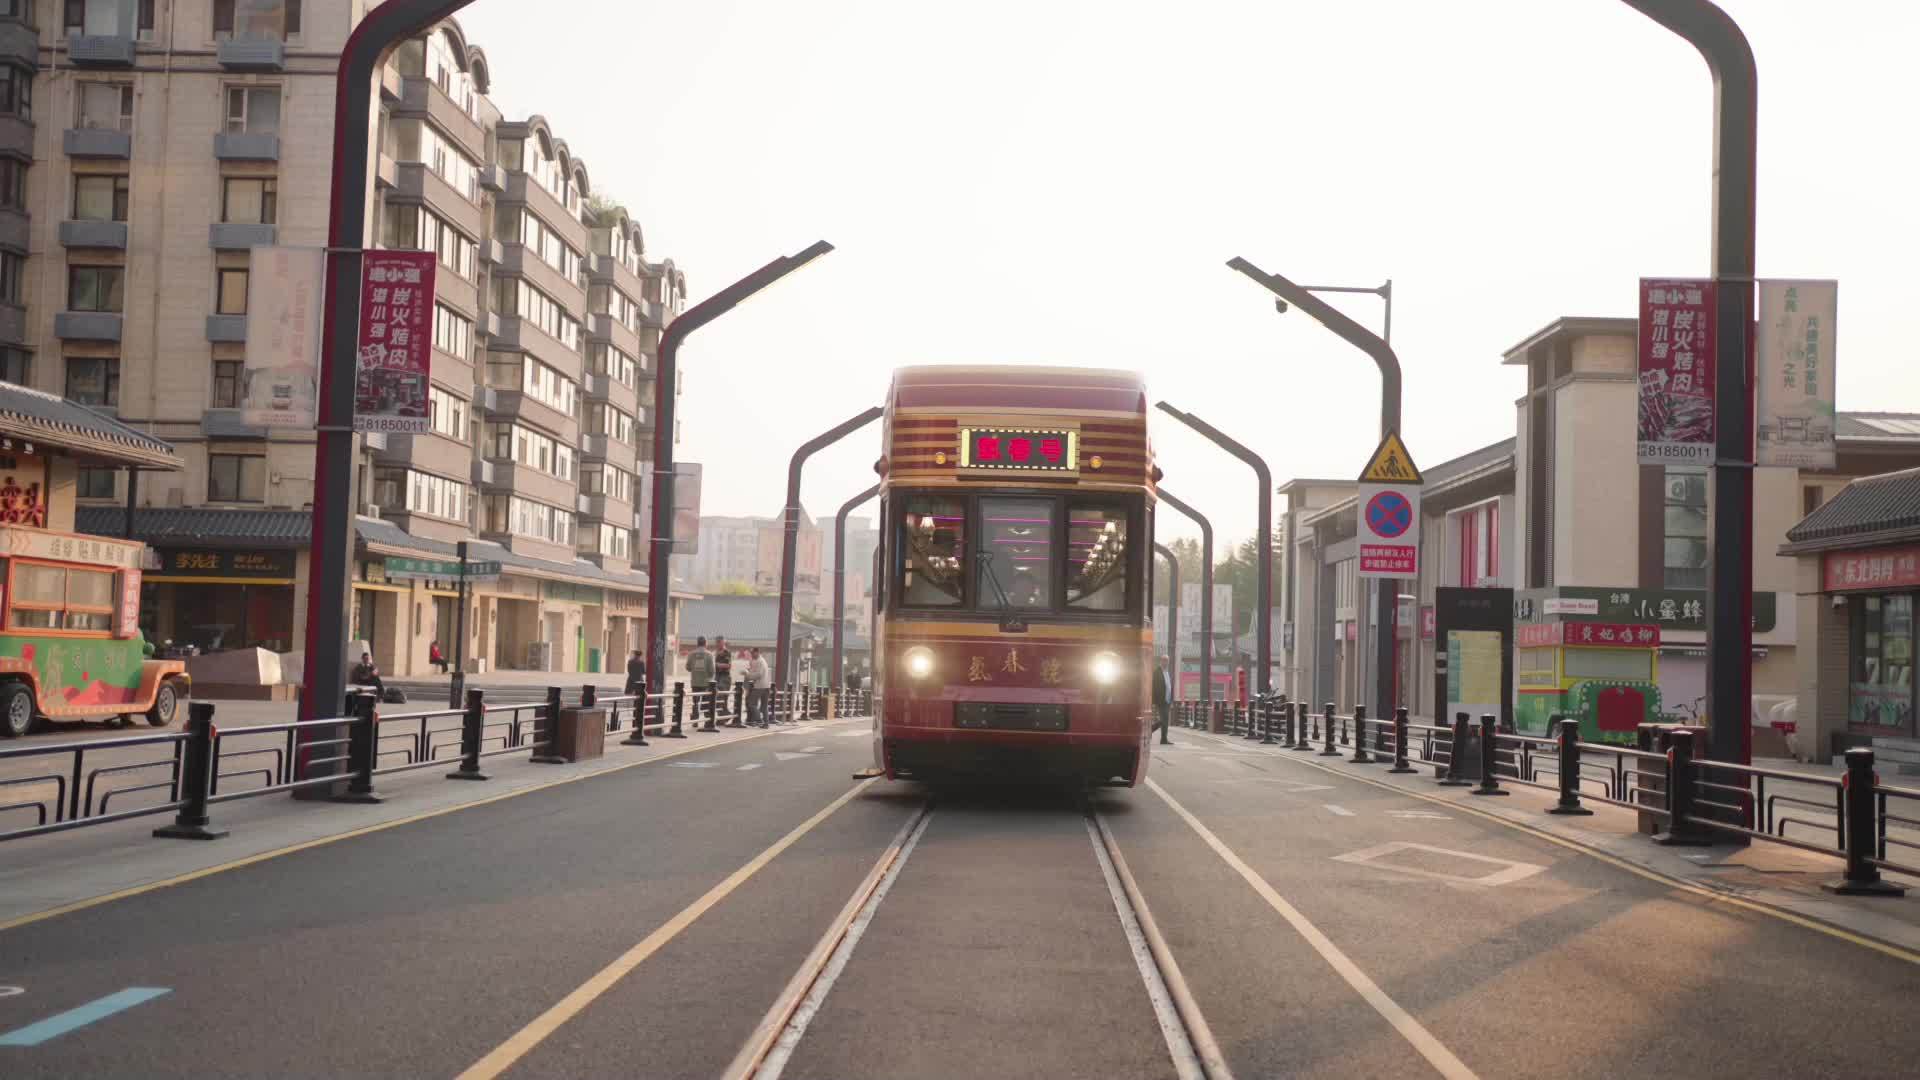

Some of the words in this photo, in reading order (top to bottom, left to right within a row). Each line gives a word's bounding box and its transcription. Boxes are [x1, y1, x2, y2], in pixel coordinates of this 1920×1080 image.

[389, 288, 411, 367] 炭火烤肉
[1672, 310, 1695, 392] 炭火烤肉
[366, 419, 424, 432] 81850011
[1648, 445, 1709, 457] 81850011
[1610, 593, 1630, 604] 台湾
[1634, 599, 1703, 624] 小蜜蜂
